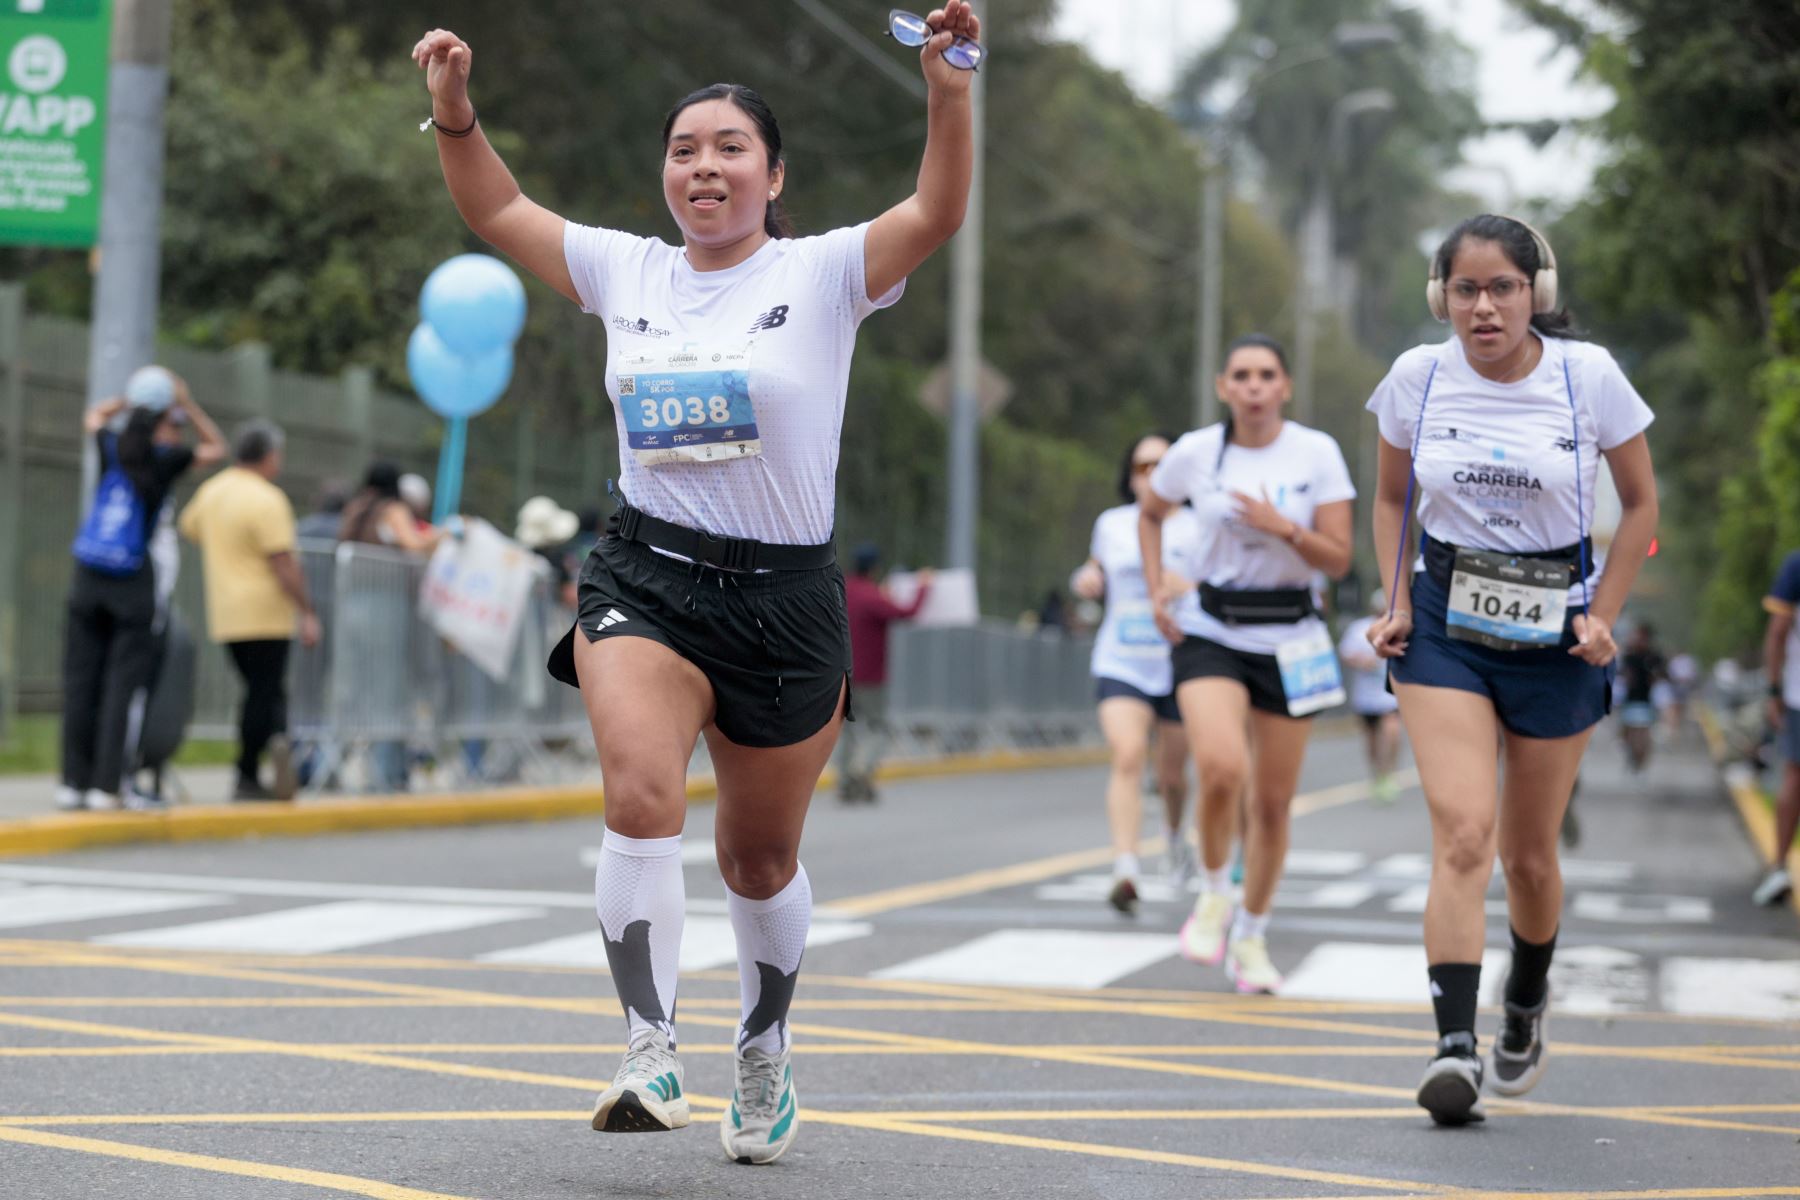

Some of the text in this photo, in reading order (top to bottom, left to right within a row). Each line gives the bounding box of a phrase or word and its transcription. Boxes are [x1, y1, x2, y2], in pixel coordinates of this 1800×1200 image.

[640, 395, 730, 428] 3038
[673, 433, 691, 443] FPC
[1453, 471, 1543, 491] CARRERA
[1470, 592, 1543, 624] 1044
